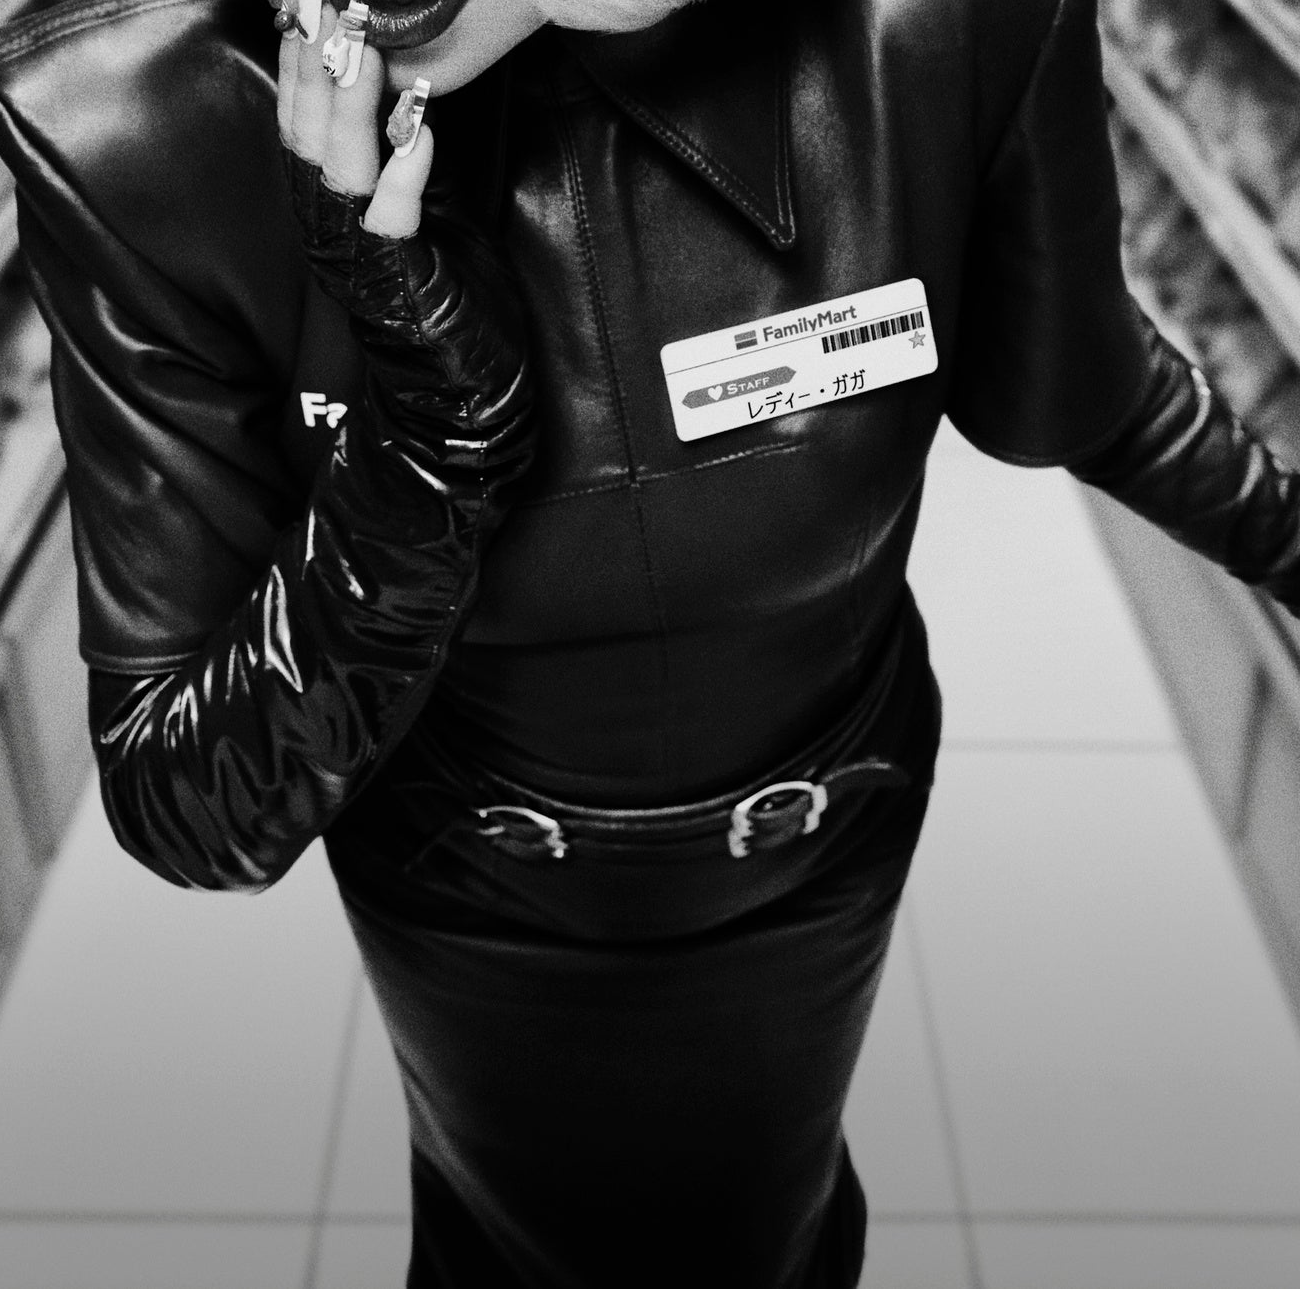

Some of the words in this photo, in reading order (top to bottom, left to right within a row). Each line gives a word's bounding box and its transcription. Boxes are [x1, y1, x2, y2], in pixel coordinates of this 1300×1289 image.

[762, 305, 858, 343] FamilyMart
[726, 376, 771, 395] STAFF
[747, 369, 867, 419] レディー・ガガ
